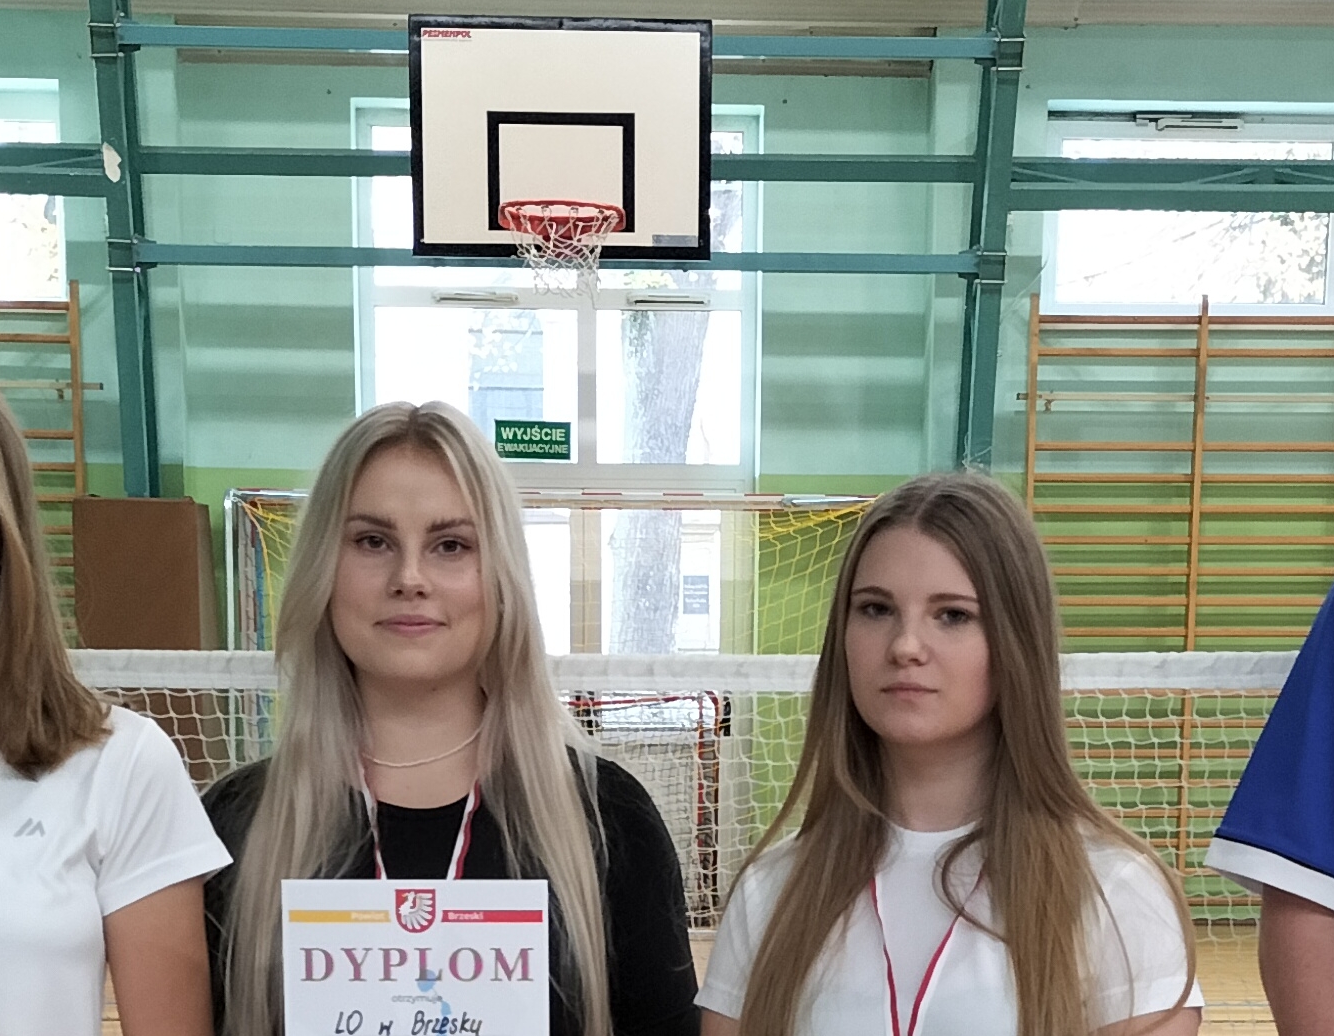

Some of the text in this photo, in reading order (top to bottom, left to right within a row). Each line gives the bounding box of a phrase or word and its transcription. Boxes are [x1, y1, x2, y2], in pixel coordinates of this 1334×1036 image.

[500, 424, 566, 441] WYJŚCIE
[497, 442, 569, 454] EWAKUACYJNE
[350, 912, 484, 921] Powiat Brzeski
[299, 947, 535, 982] DYPLOM
[391, 994, 443, 1005] otrzymuje
[334, 1010, 364, 1035] LO
[411, 1010, 483, 1036] Brzesku
